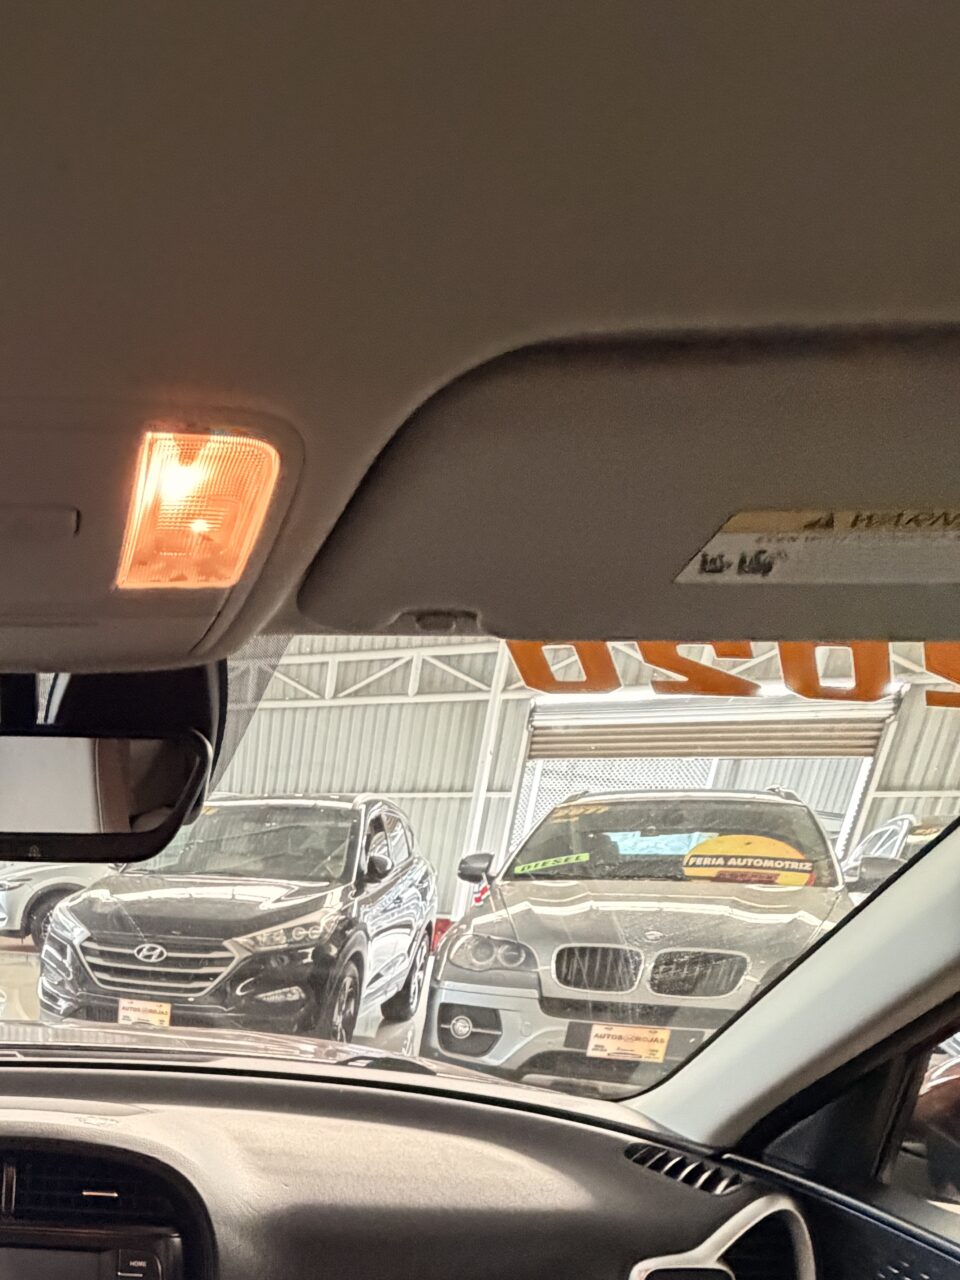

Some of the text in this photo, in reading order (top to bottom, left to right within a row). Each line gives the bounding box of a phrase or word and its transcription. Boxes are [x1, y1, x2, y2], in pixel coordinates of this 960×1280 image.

[520, 855, 583, 871] DIESEL
[689, 856, 813, 870] FERIA AUTOMOTRIZ
